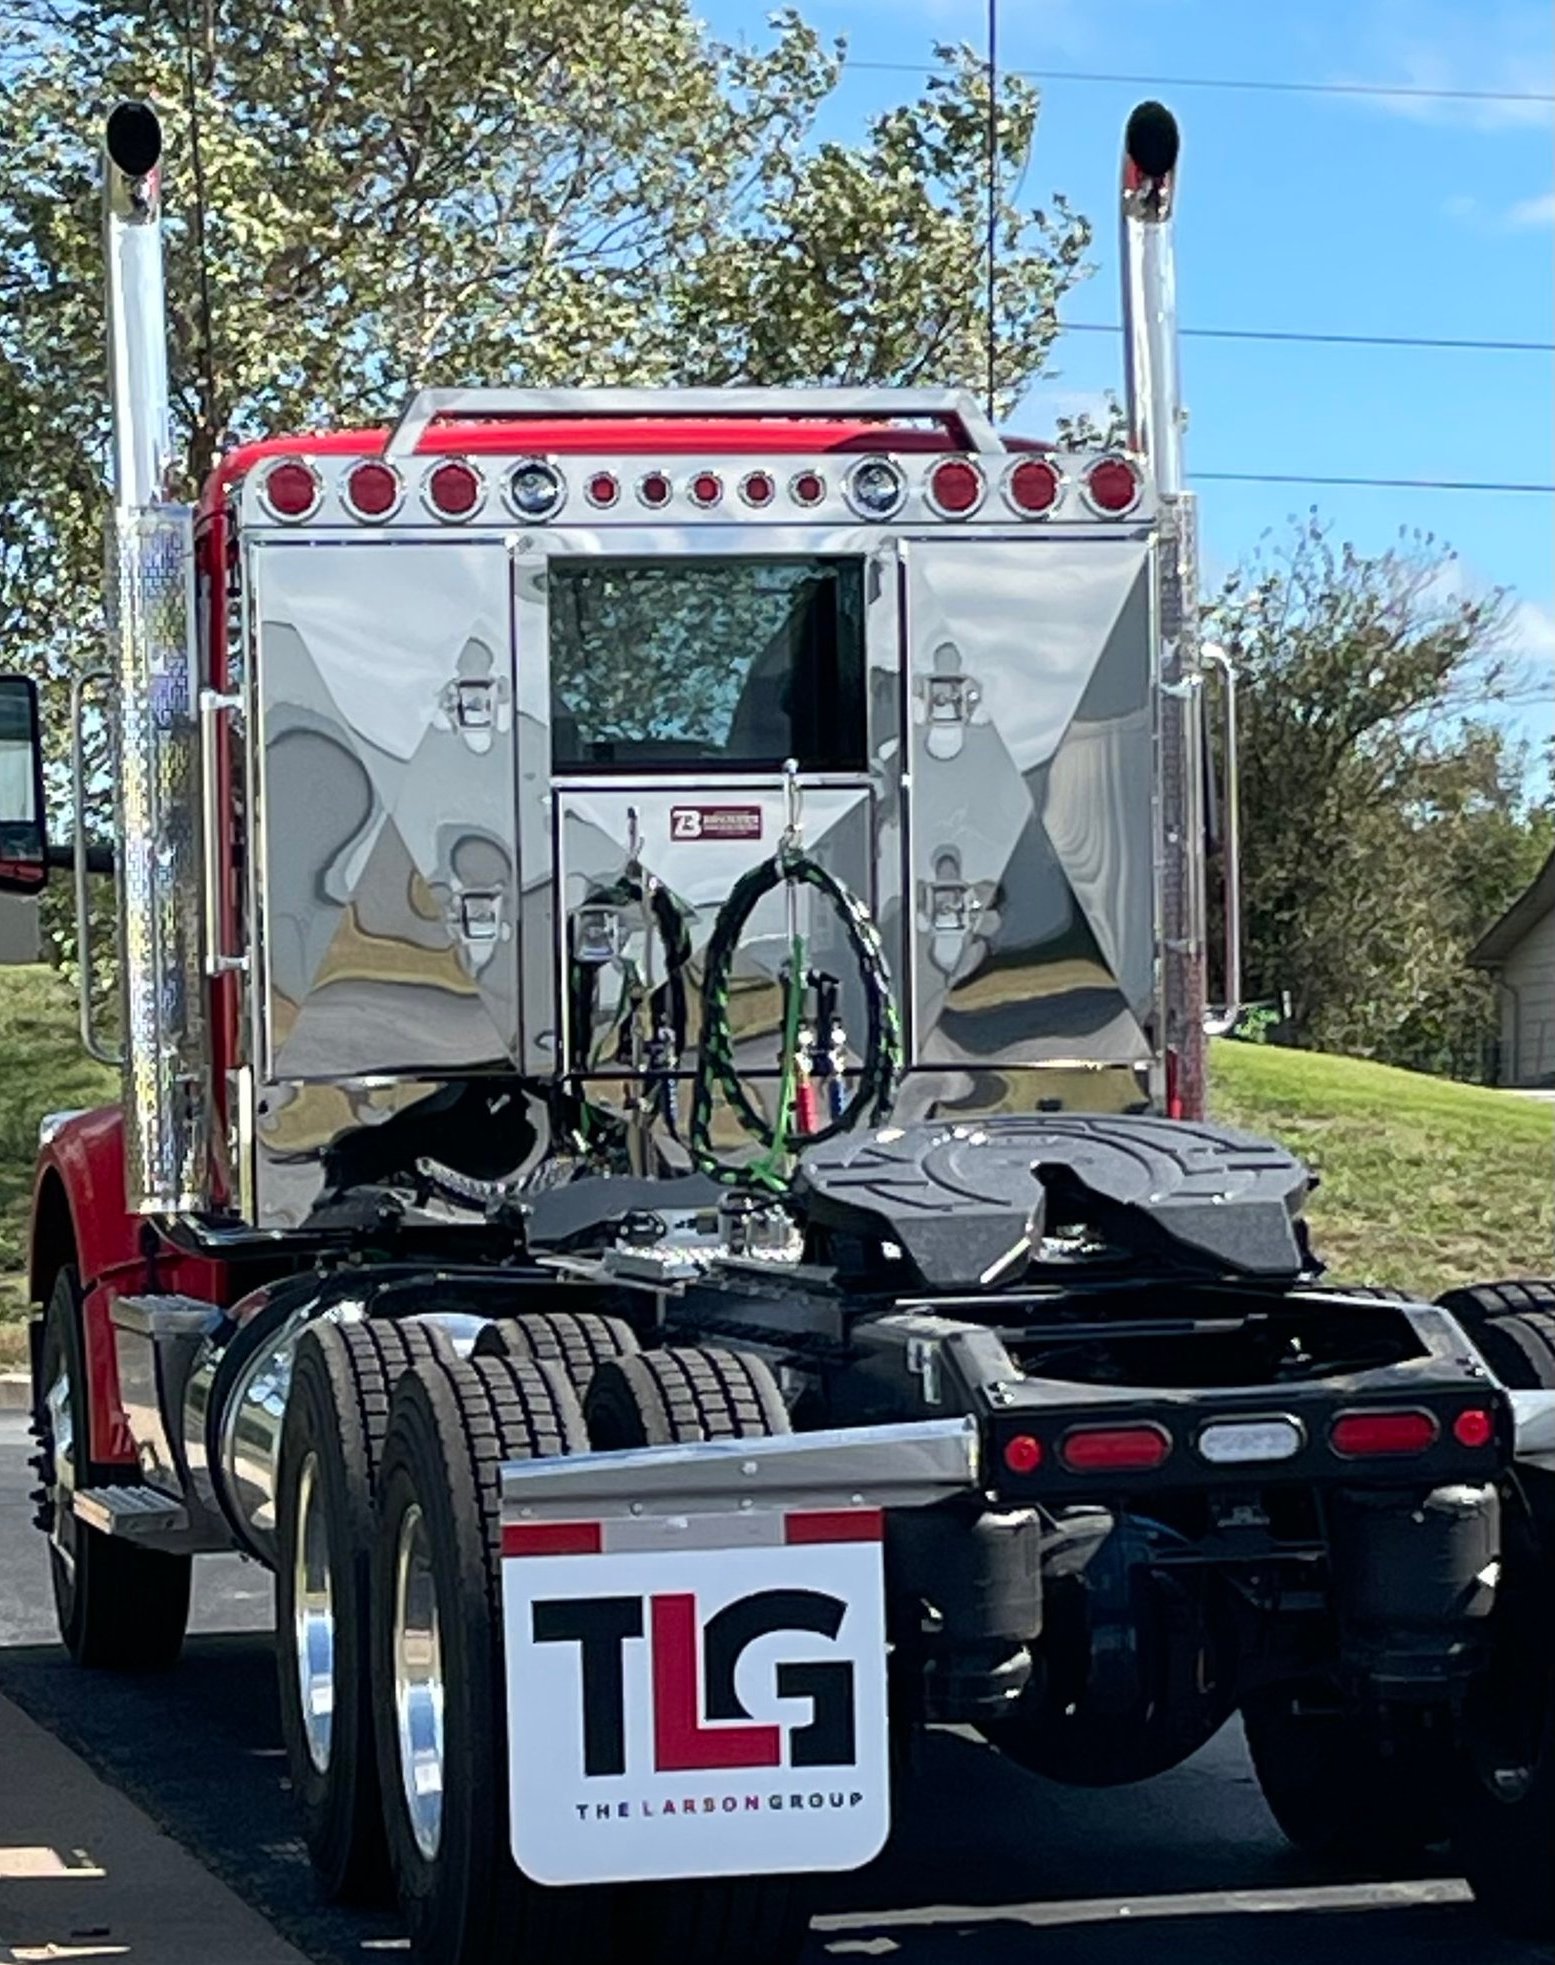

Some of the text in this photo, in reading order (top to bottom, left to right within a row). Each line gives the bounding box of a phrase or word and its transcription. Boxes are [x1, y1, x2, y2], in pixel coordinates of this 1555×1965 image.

[531, 1588, 856, 1777] TLG
[576, 1791, 864, 1820] THE LARSON GROUP
